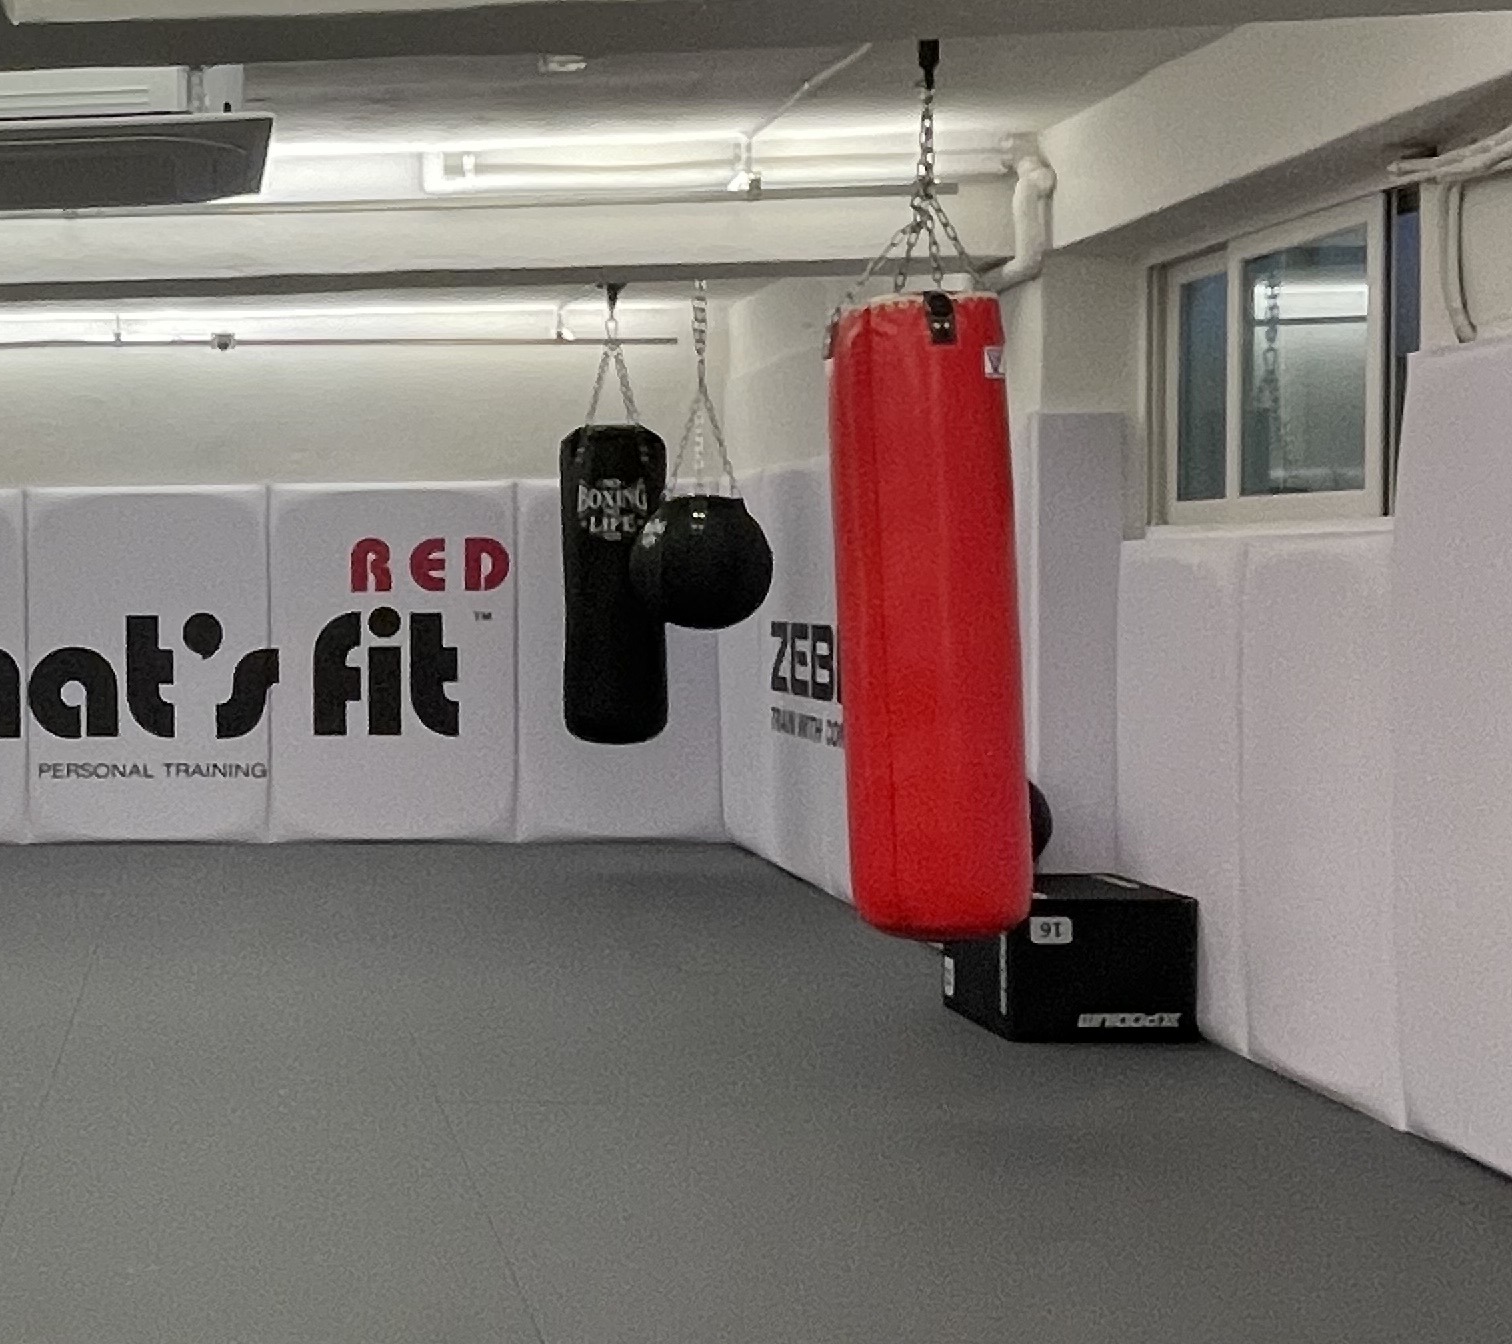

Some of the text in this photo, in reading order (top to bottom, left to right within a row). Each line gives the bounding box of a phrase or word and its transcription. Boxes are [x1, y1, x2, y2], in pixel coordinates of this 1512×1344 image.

[350, 536, 511, 593] RED
[313, 605, 460, 737] fit
[770, 620, 843, 703] ZEB
[37, 761, 268, 780] PERSONAL TRAINING
